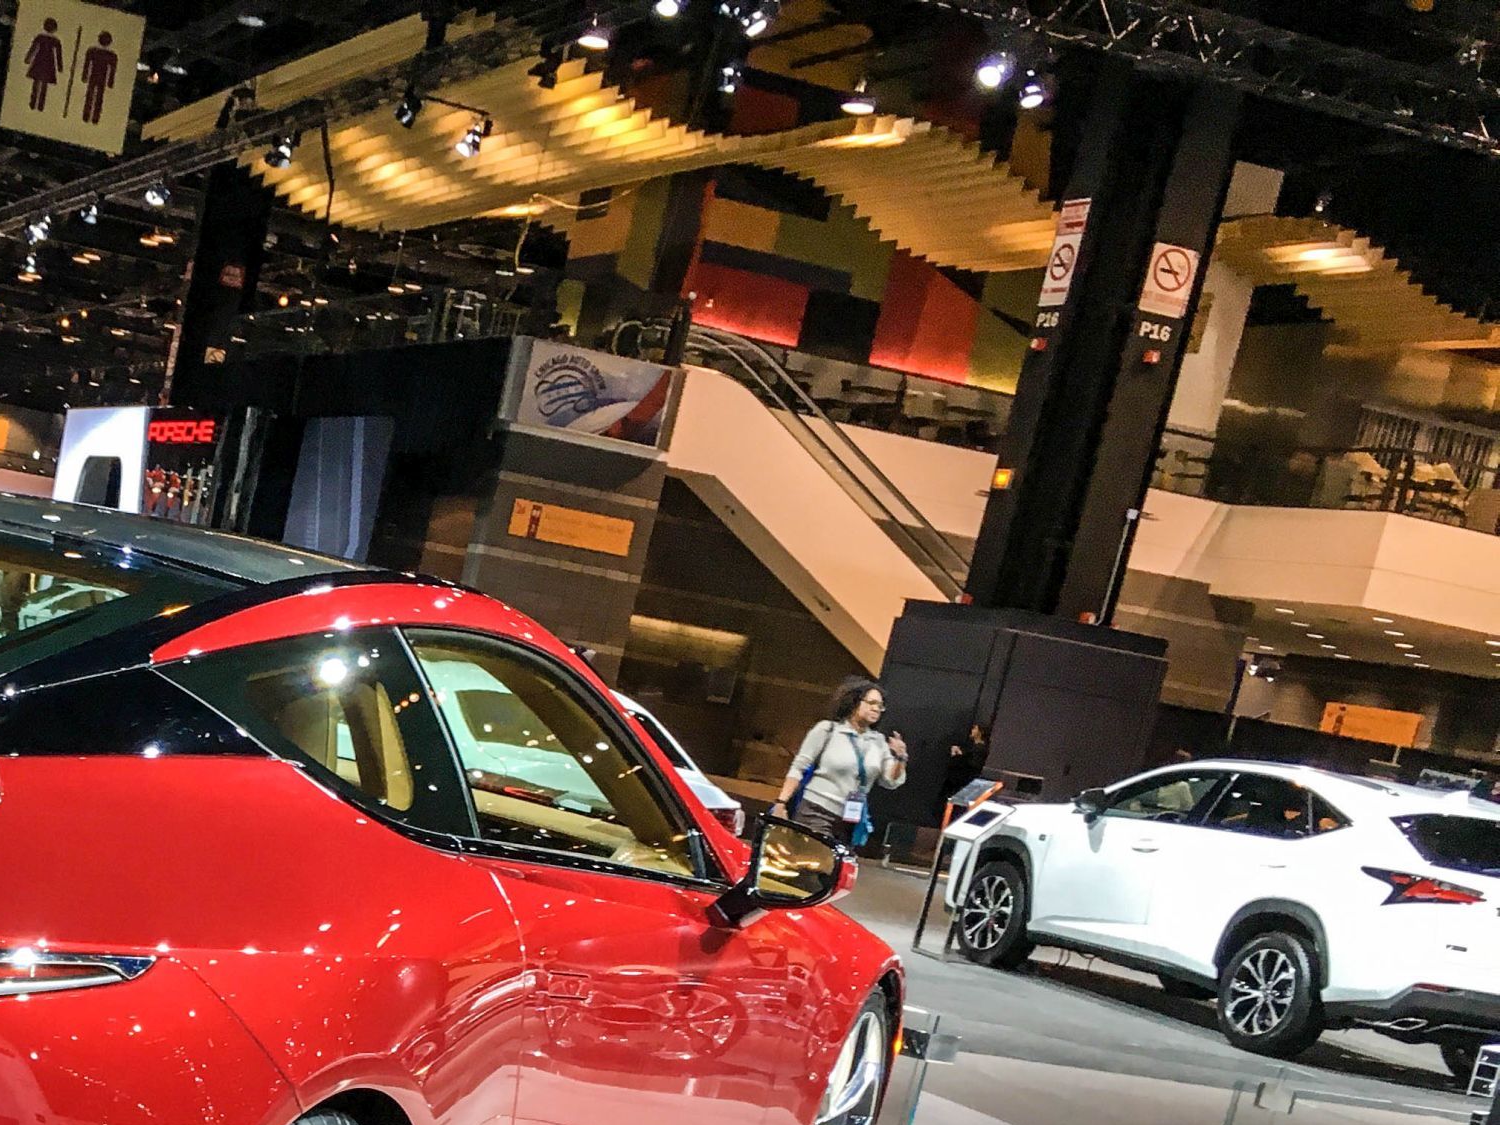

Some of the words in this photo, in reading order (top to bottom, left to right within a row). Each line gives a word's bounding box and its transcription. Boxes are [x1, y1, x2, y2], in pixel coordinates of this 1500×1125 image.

[1036, 312, 1059, 328] P16
[1139, 321, 1172, 342] P16
[570, 355, 591, 369] AUTO
[148, 419, 215, 443] PORSCHE
